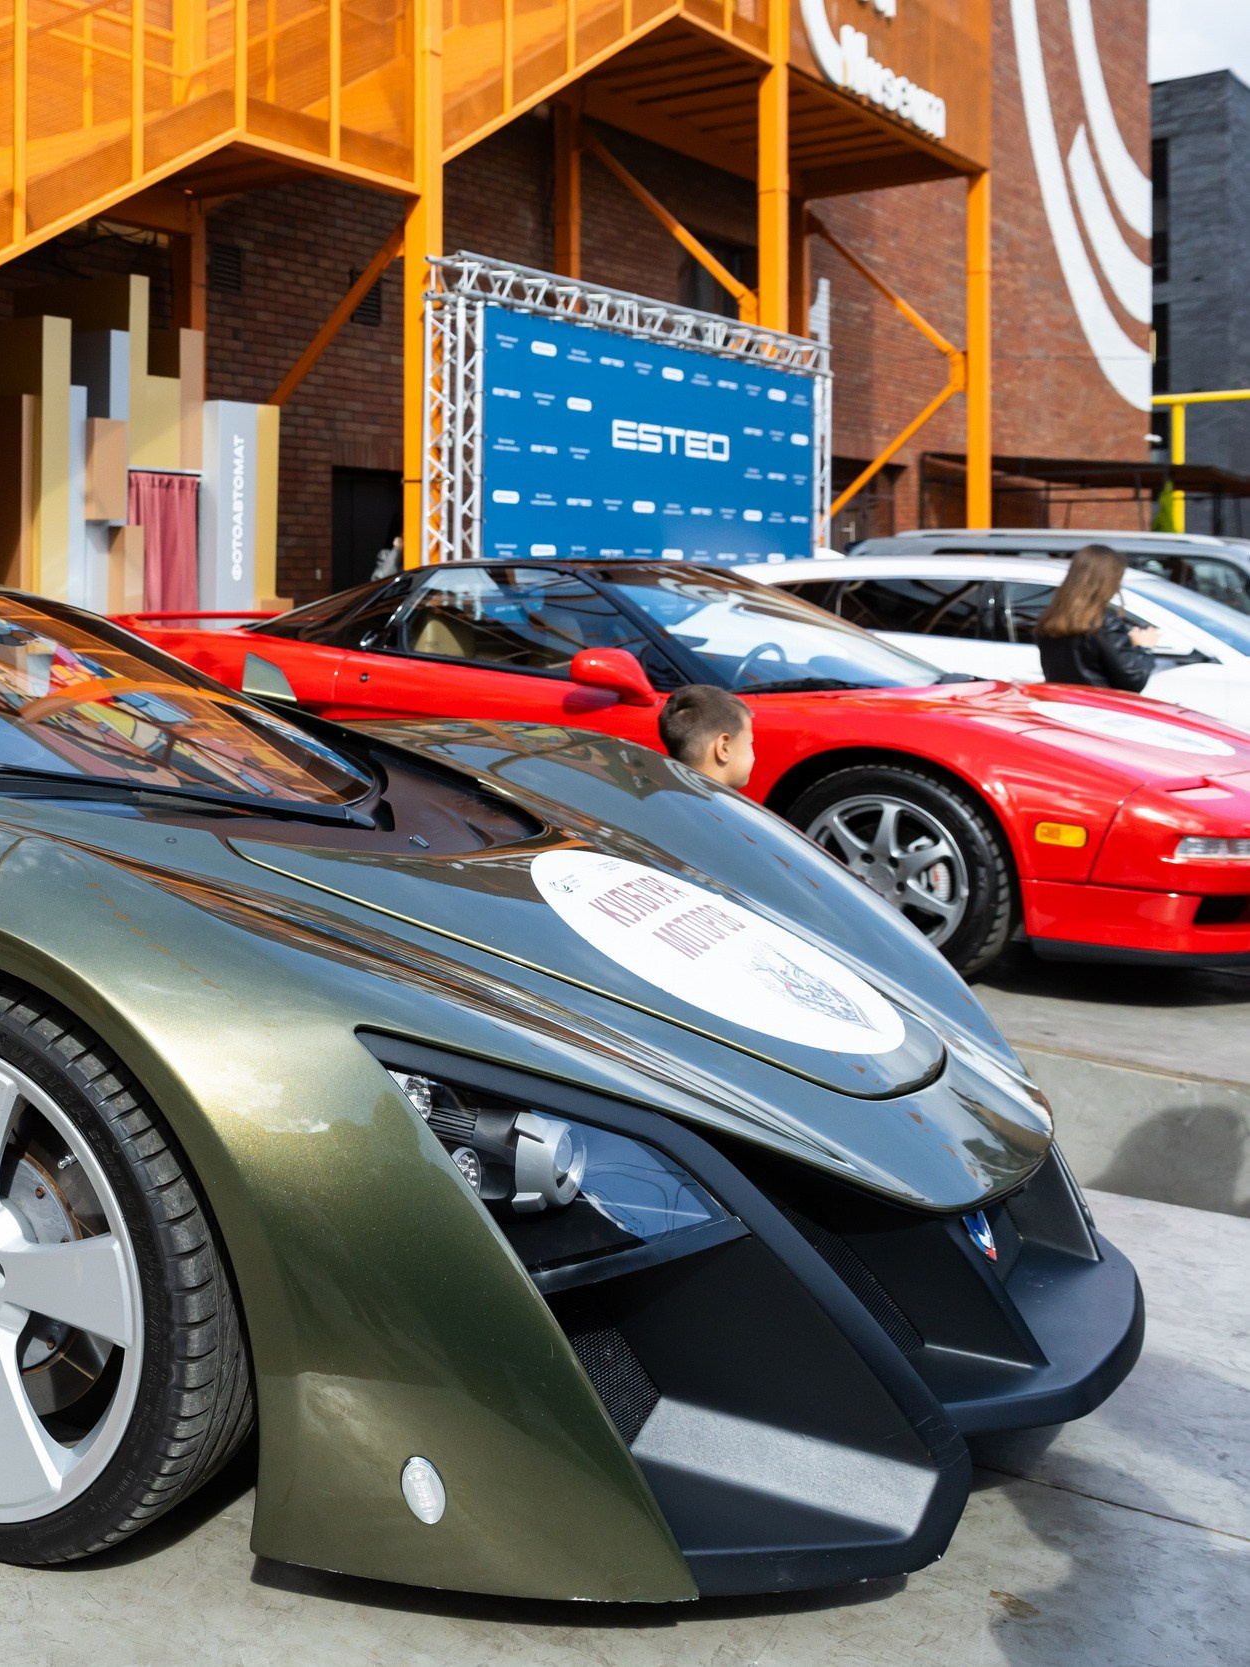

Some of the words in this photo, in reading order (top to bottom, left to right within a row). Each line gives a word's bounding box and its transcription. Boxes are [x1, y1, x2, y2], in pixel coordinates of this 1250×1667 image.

[231, 434, 246, 582] ФОТОАВТОМАТ
[588, 875, 690, 928] КУЛЬТУРА
[651, 904, 747, 961] МОТОРОВ
